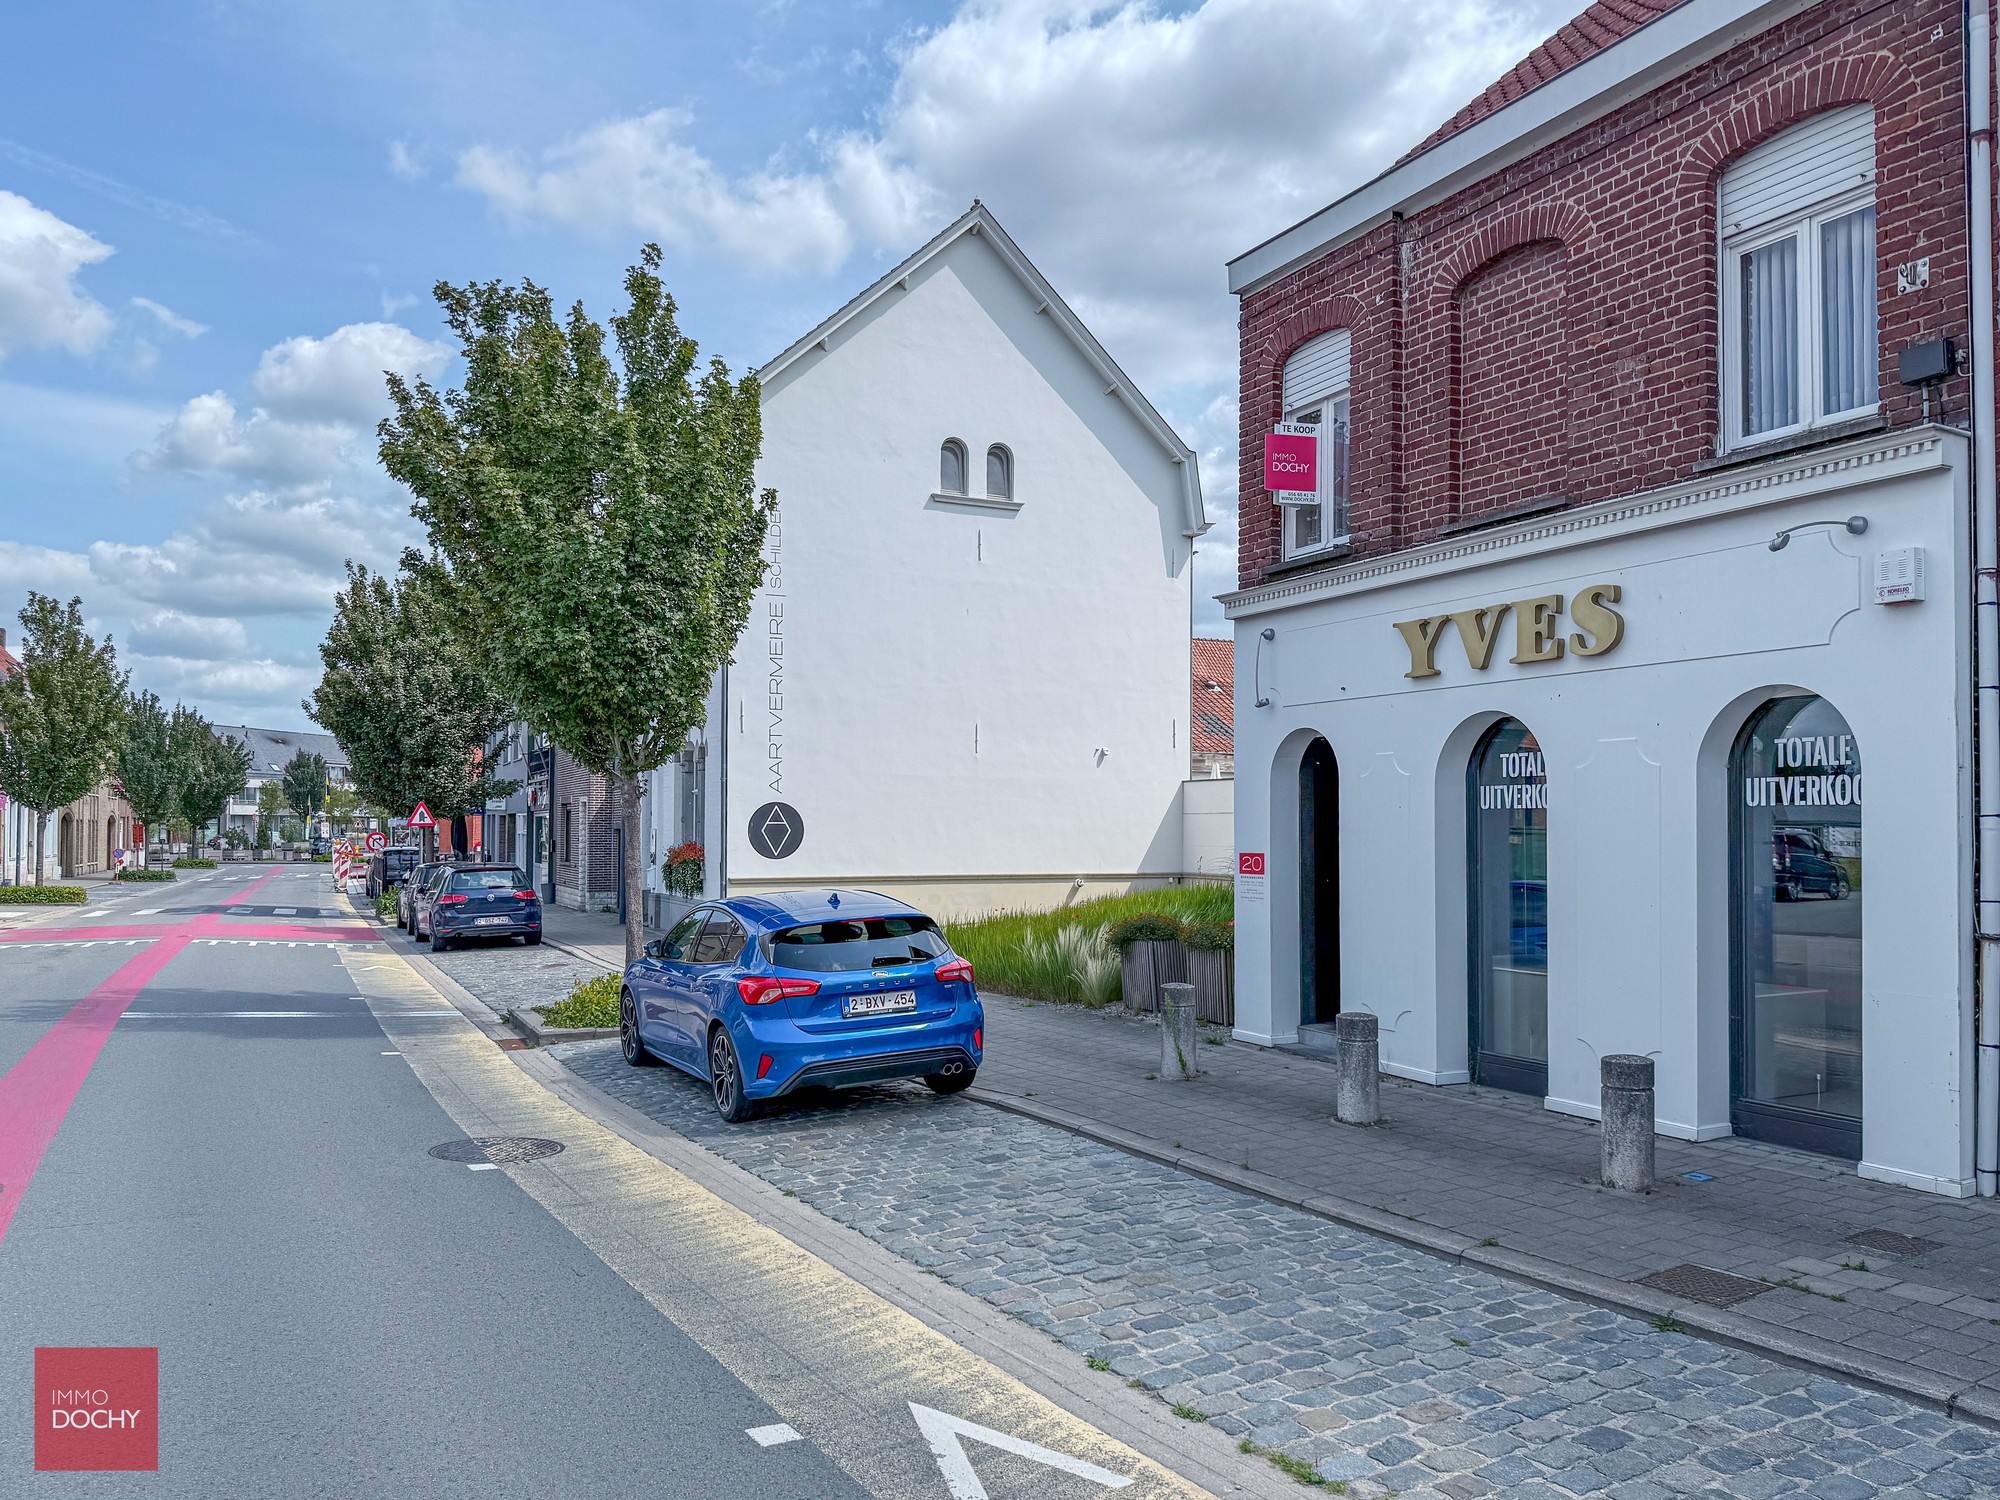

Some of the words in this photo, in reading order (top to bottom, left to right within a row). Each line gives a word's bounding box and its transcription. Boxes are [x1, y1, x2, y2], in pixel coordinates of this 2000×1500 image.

[1294, 426, 1316, 434] KOOP
[1273, 453, 1296, 461] IMMO
[1273, 462, 1309, 473] DOCHY
[1392, 584, 1625, 679] YVES
[1774, 735, 1852, 768] TOTALE
[1242, 856, 1262, 871] 20
